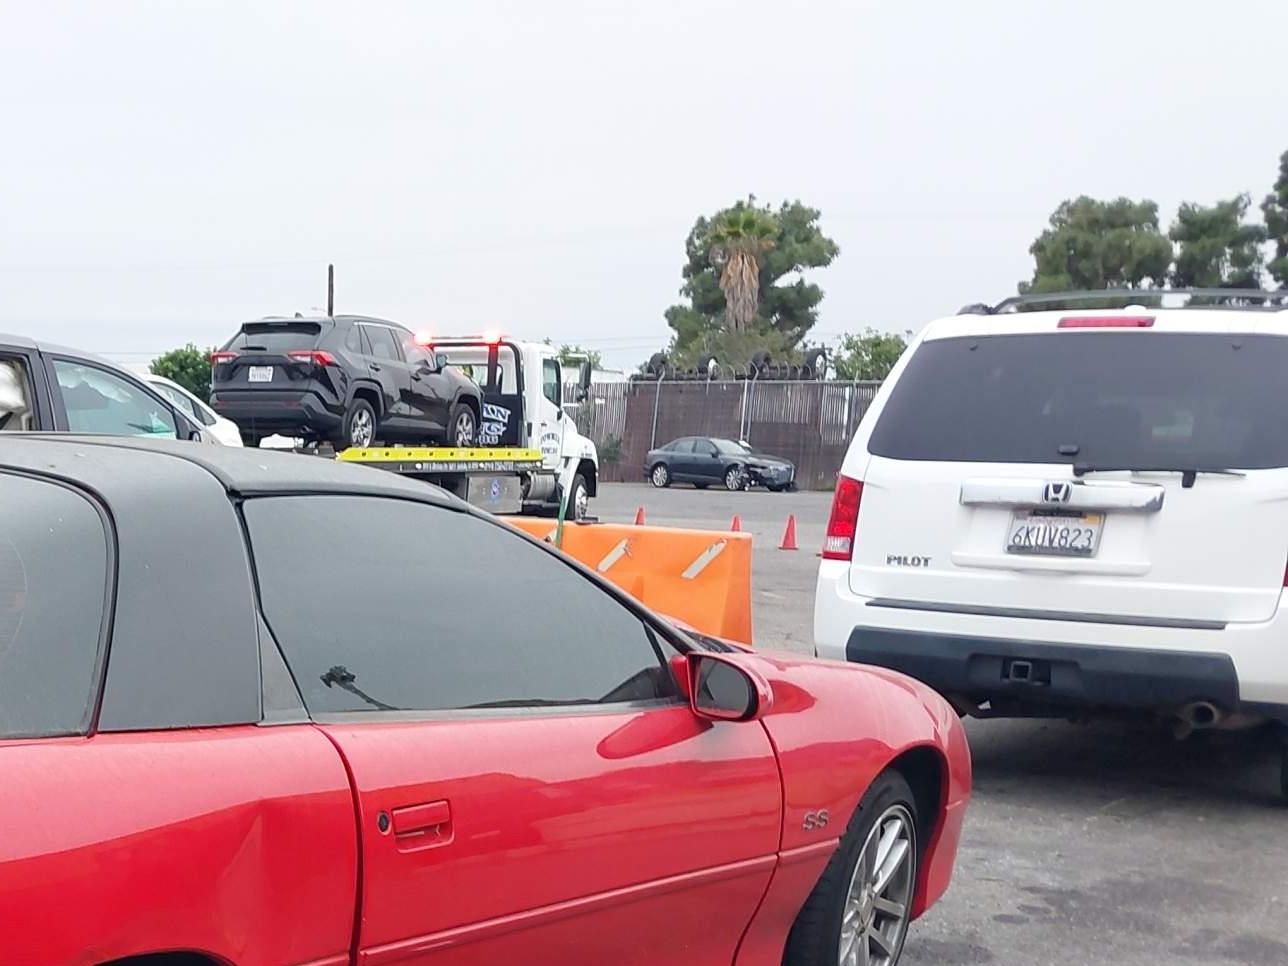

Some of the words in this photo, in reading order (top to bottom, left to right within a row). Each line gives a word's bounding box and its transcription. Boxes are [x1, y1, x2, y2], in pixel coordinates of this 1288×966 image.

[1012, 526, 1093, 549] 6KUV823
[886, 554, 932, 567] PILOT
[802, 808, 829, 832] SS
